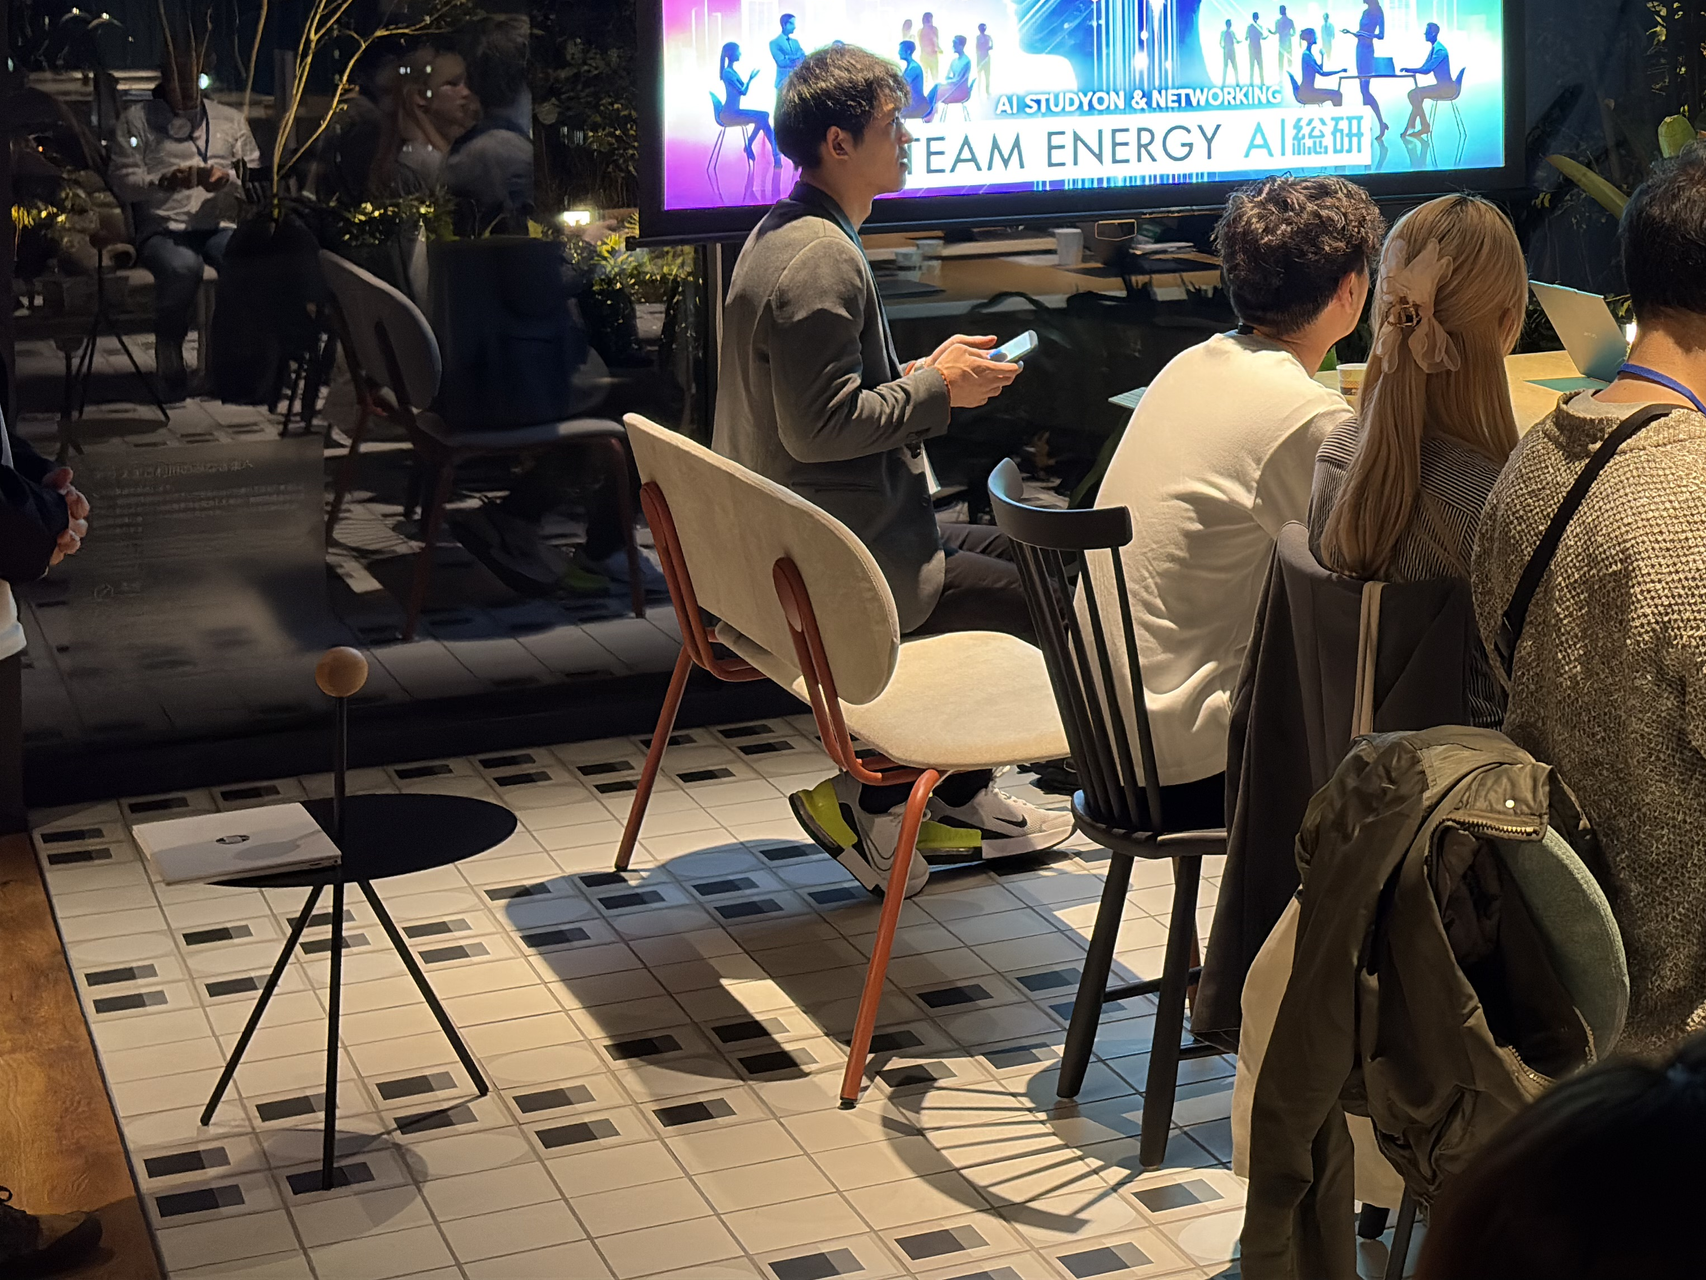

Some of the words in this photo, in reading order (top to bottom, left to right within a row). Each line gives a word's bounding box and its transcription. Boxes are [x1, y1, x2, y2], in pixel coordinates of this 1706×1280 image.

[996, 95, 1018, 114] AI
[1024, 90, 1125, 113] STUDYON
[1131, 88, 1148, 109] &
[1151, 85, 1283, 108] NETWORKING
[1047, 123, 1222, 168] ENERGY
